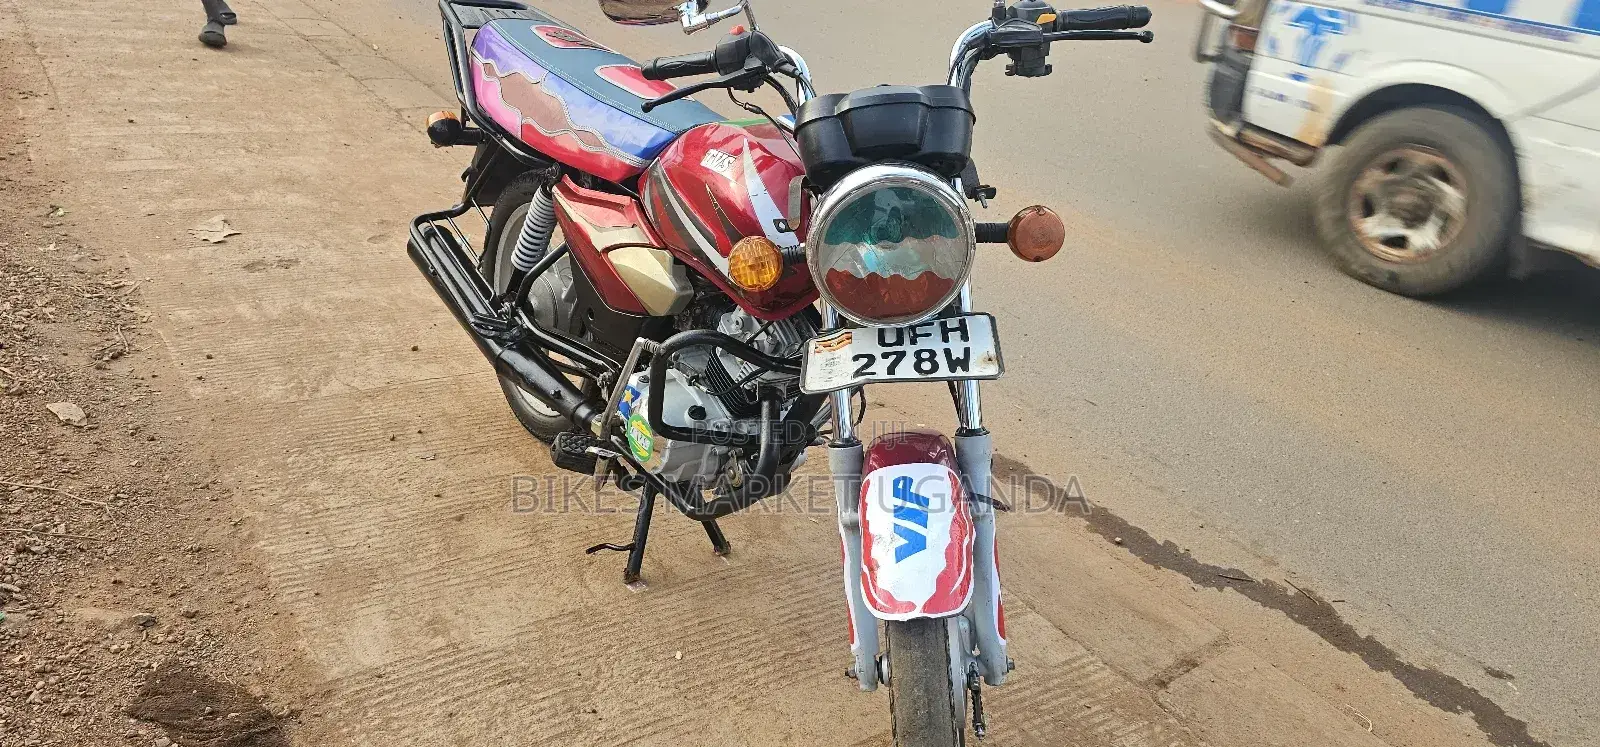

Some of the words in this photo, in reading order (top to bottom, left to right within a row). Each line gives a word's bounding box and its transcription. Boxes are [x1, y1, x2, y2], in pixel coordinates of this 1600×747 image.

[877, 318, 970, 348] UFH
[851, 346, 971, 376] 278W
[892, 475, 930, 564] VIP
